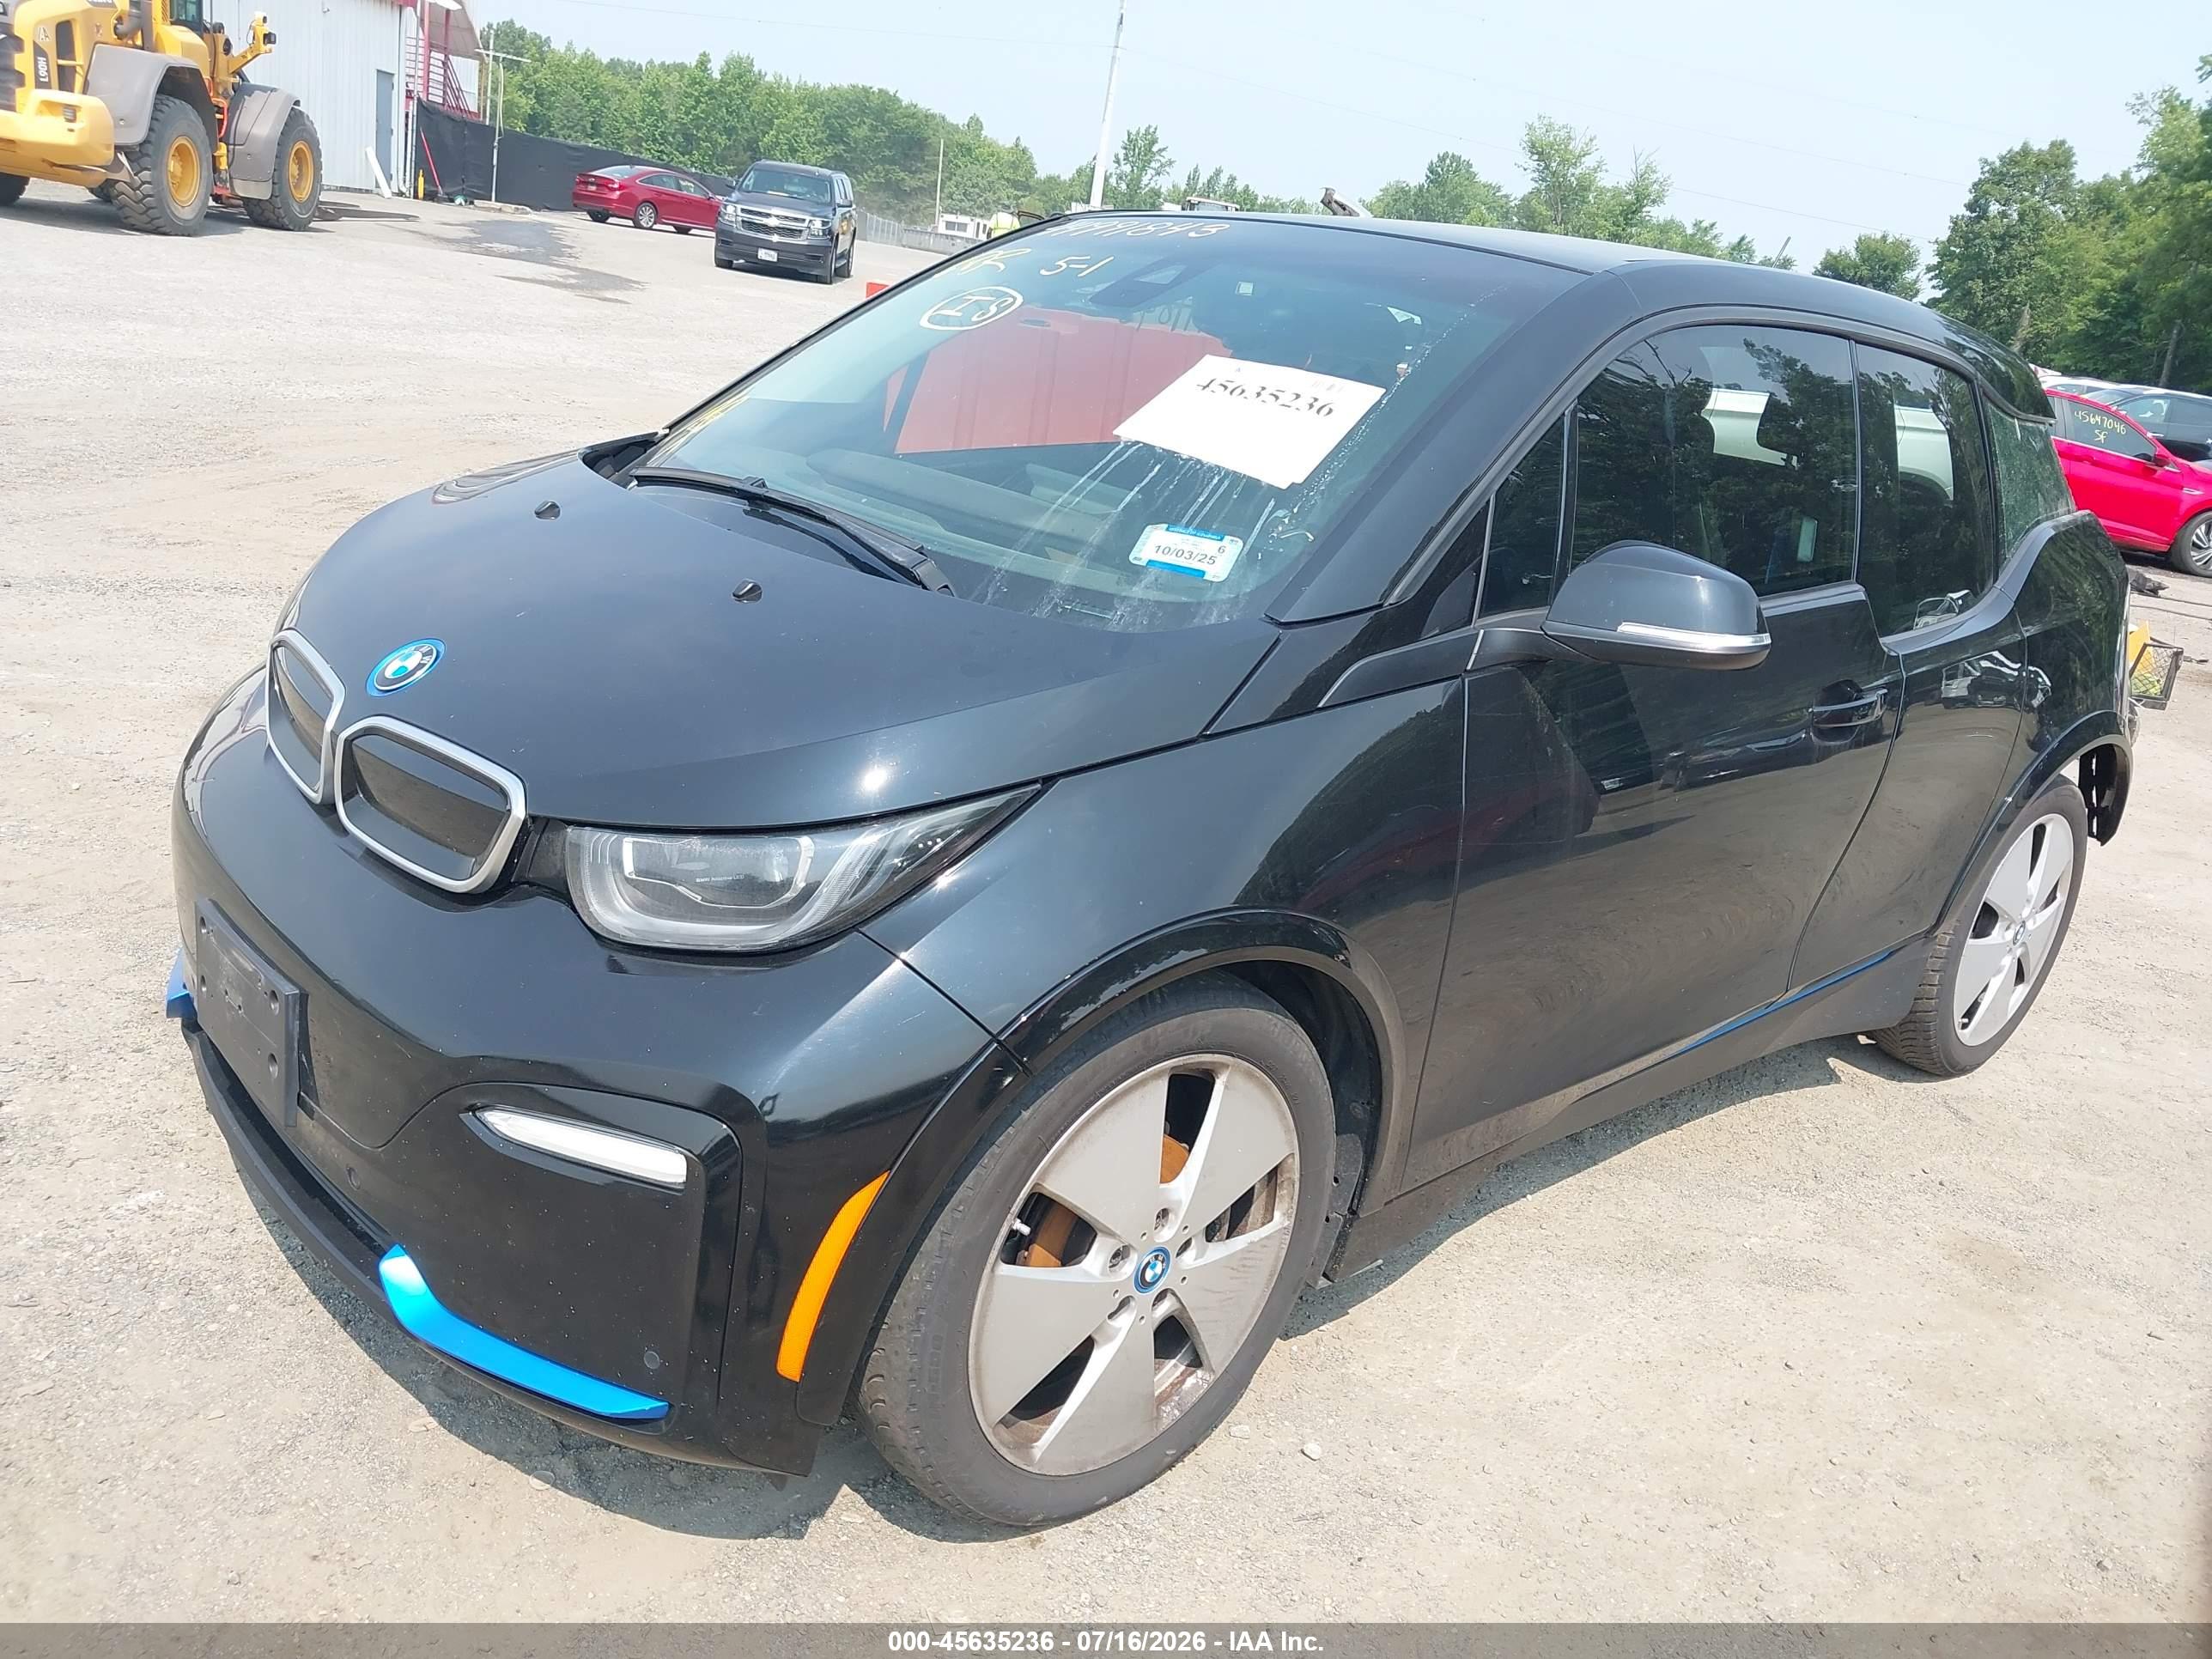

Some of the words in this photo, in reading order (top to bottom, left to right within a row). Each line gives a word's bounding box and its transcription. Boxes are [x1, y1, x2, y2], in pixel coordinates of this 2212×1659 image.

[37, 57, 49, 82] L90H
[1196, 378, 1334, 417] 45635236
[2074, 410, 2127, 434] 45647046
[1154, 544, 1218, 566] 10/03/25
[1217, 545, 1227, 555] 6
